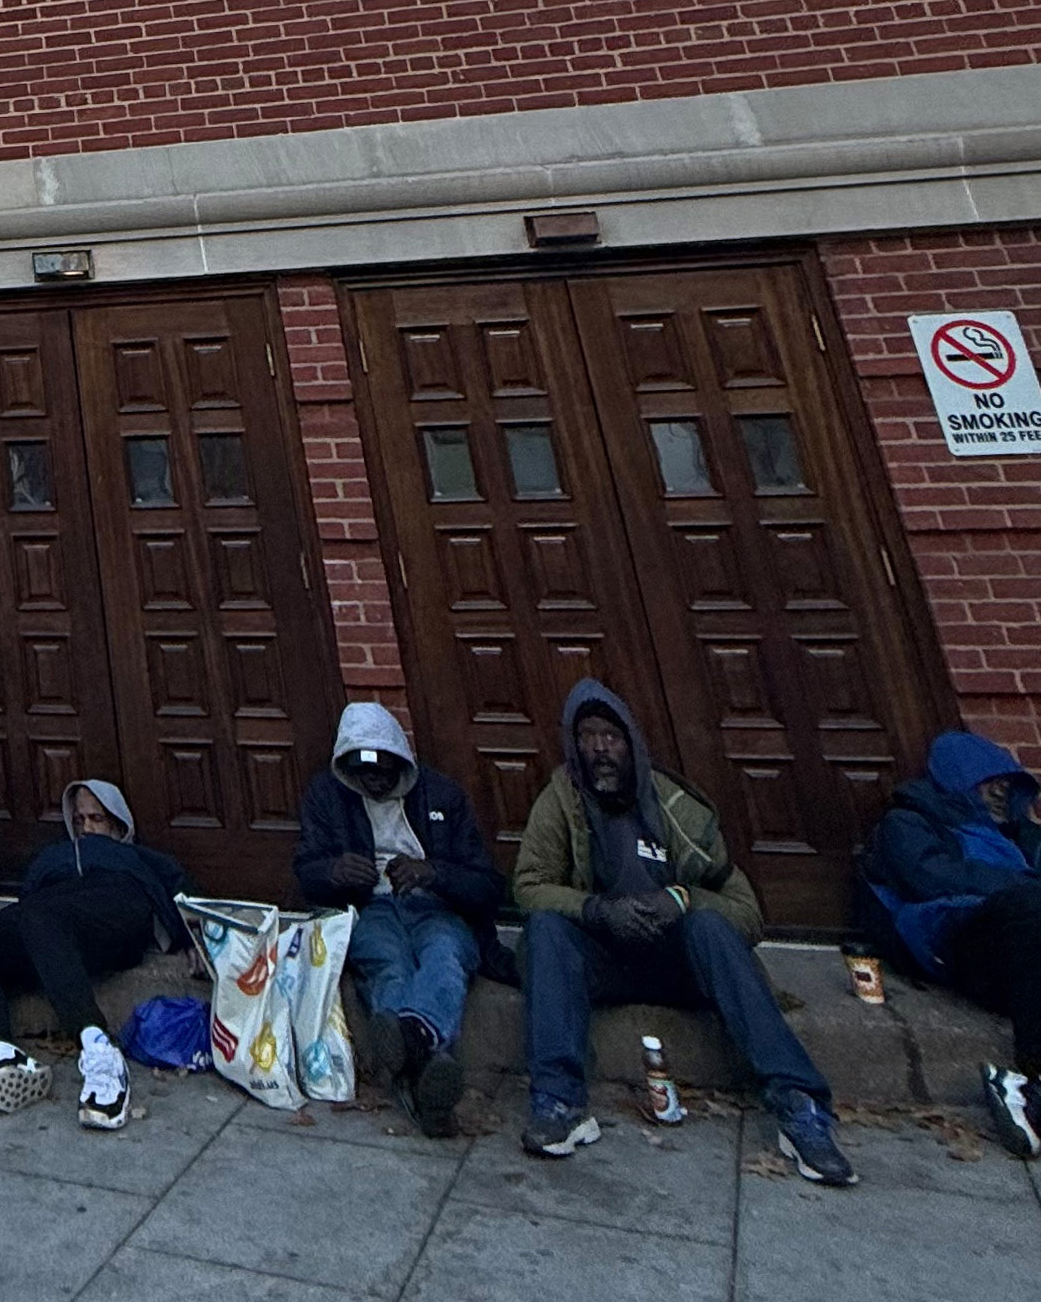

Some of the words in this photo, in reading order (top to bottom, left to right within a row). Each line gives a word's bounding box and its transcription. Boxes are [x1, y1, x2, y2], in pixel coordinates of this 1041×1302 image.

[973, 392, 1006, 410] NO
[947, 410, 1041, 431] SMOKING
[951, 432, 999, 444] WITHIN
[999, 431, 1017, 443] 25
